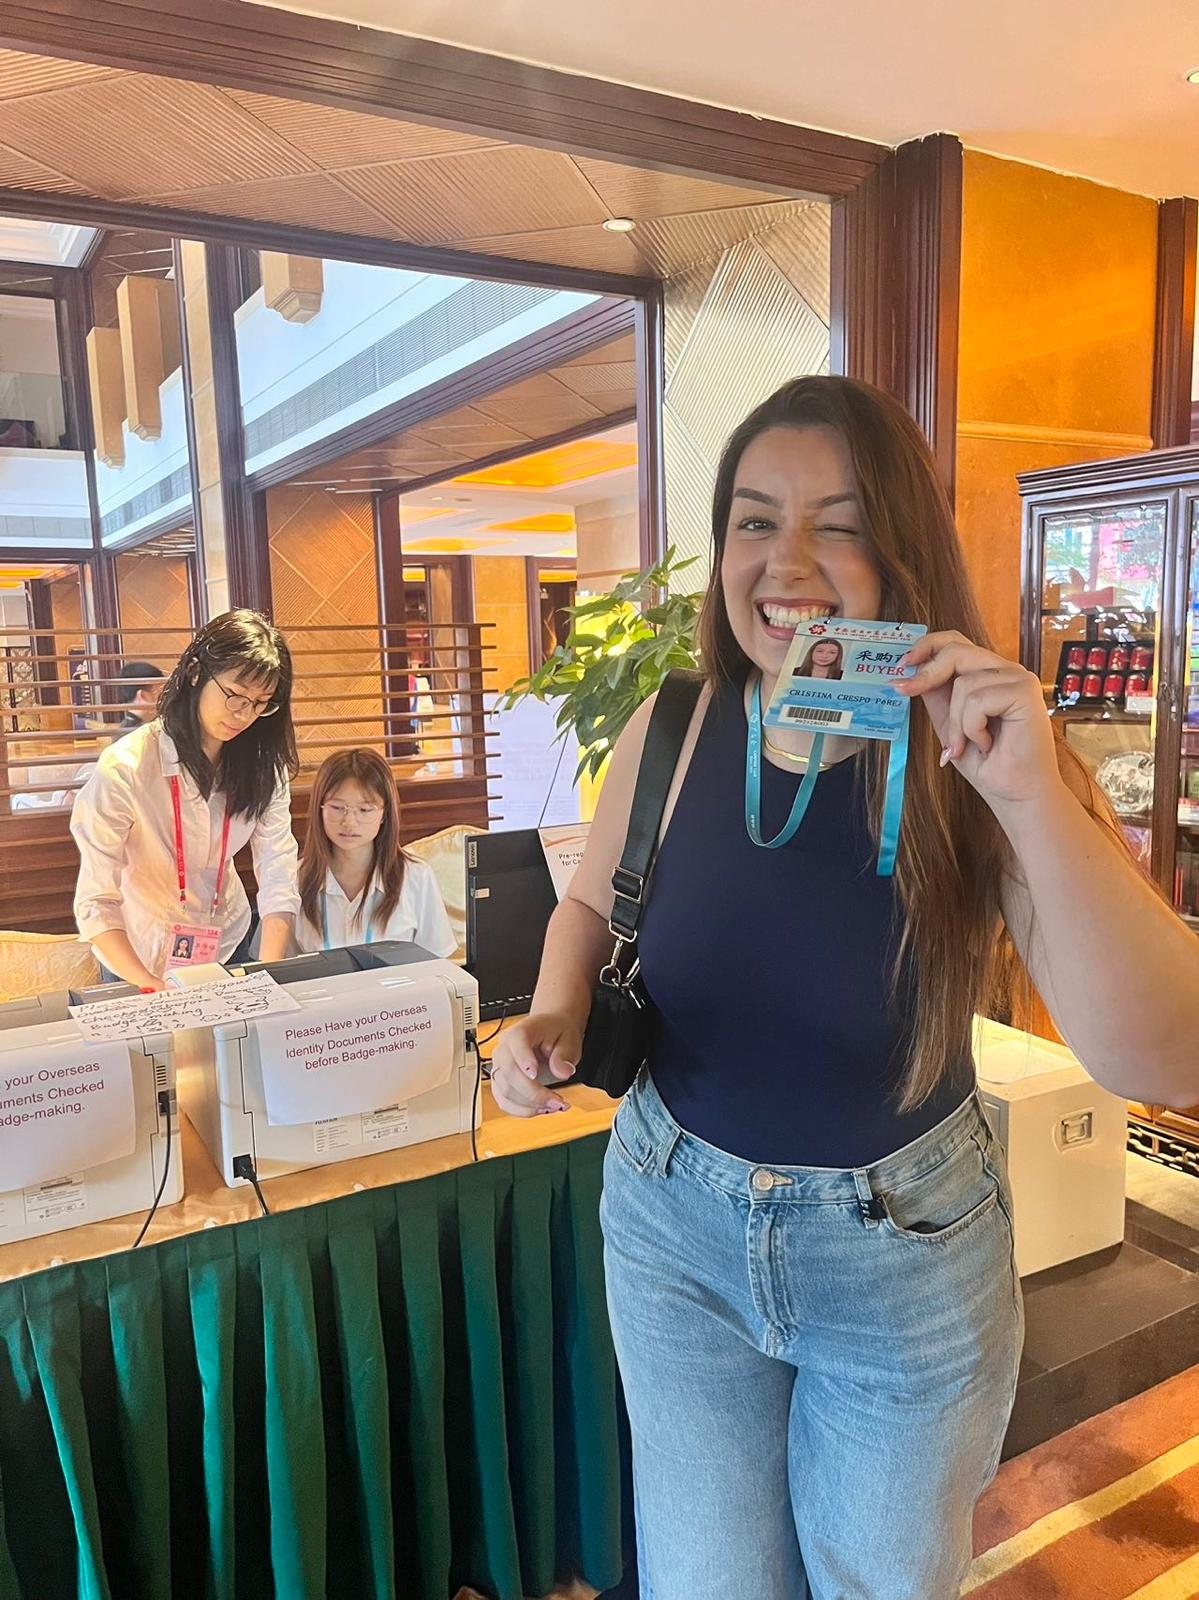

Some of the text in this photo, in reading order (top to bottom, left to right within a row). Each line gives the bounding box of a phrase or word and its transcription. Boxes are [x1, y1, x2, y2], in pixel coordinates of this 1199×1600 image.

[855, 663, 905, 676] BUYER
[789, 689, 832, 700] CRISTINA
[837, 694, 871, 704] CRESPO
[285, 1004, 427, 1040] Please Have your Overseas
[286, 1020, 432, 1058] Identity Documents Checked
[305, 1039, 417, 1070] before Badge-making.
[5, 1062, 100, 1091] your Overseas
[48, 1080, 105, 1099] Checked
